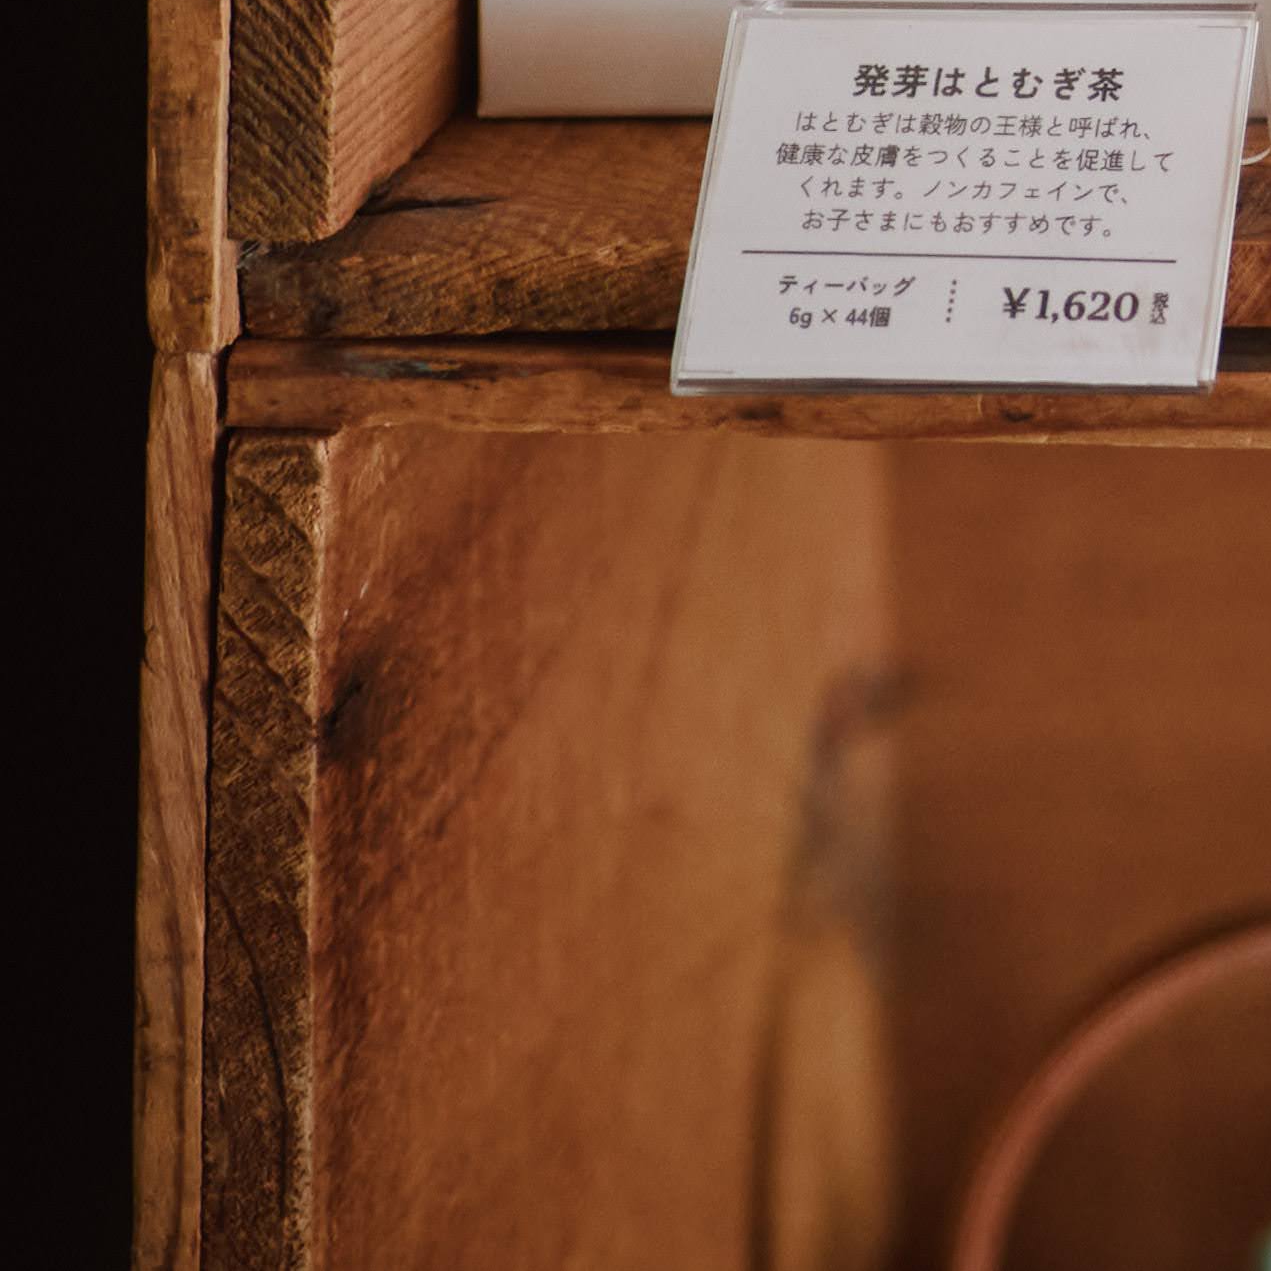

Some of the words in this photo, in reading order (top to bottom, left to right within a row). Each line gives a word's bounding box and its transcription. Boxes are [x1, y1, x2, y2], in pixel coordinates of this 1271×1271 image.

[852, 63, 1125, 103] 発芽はとむぎ茶
[795, 111, 1150, 140] はとむぎは穀物の王様と呼ばれ、
[775, 142, 1174, 173] 健康な皮膚をつくることを促進して
[800, 175, 1127, 204] くれます。ノンカフェインで、
[801, 208, 1111, 238] お子さまにもおすすめです。
[778, 275, 916, 297] ティーバッグ
[789, 306, 813, 330] 6g
[845, 306, 892, 328] 44個
[1002, 287, 1140, 324] ¥1,620
